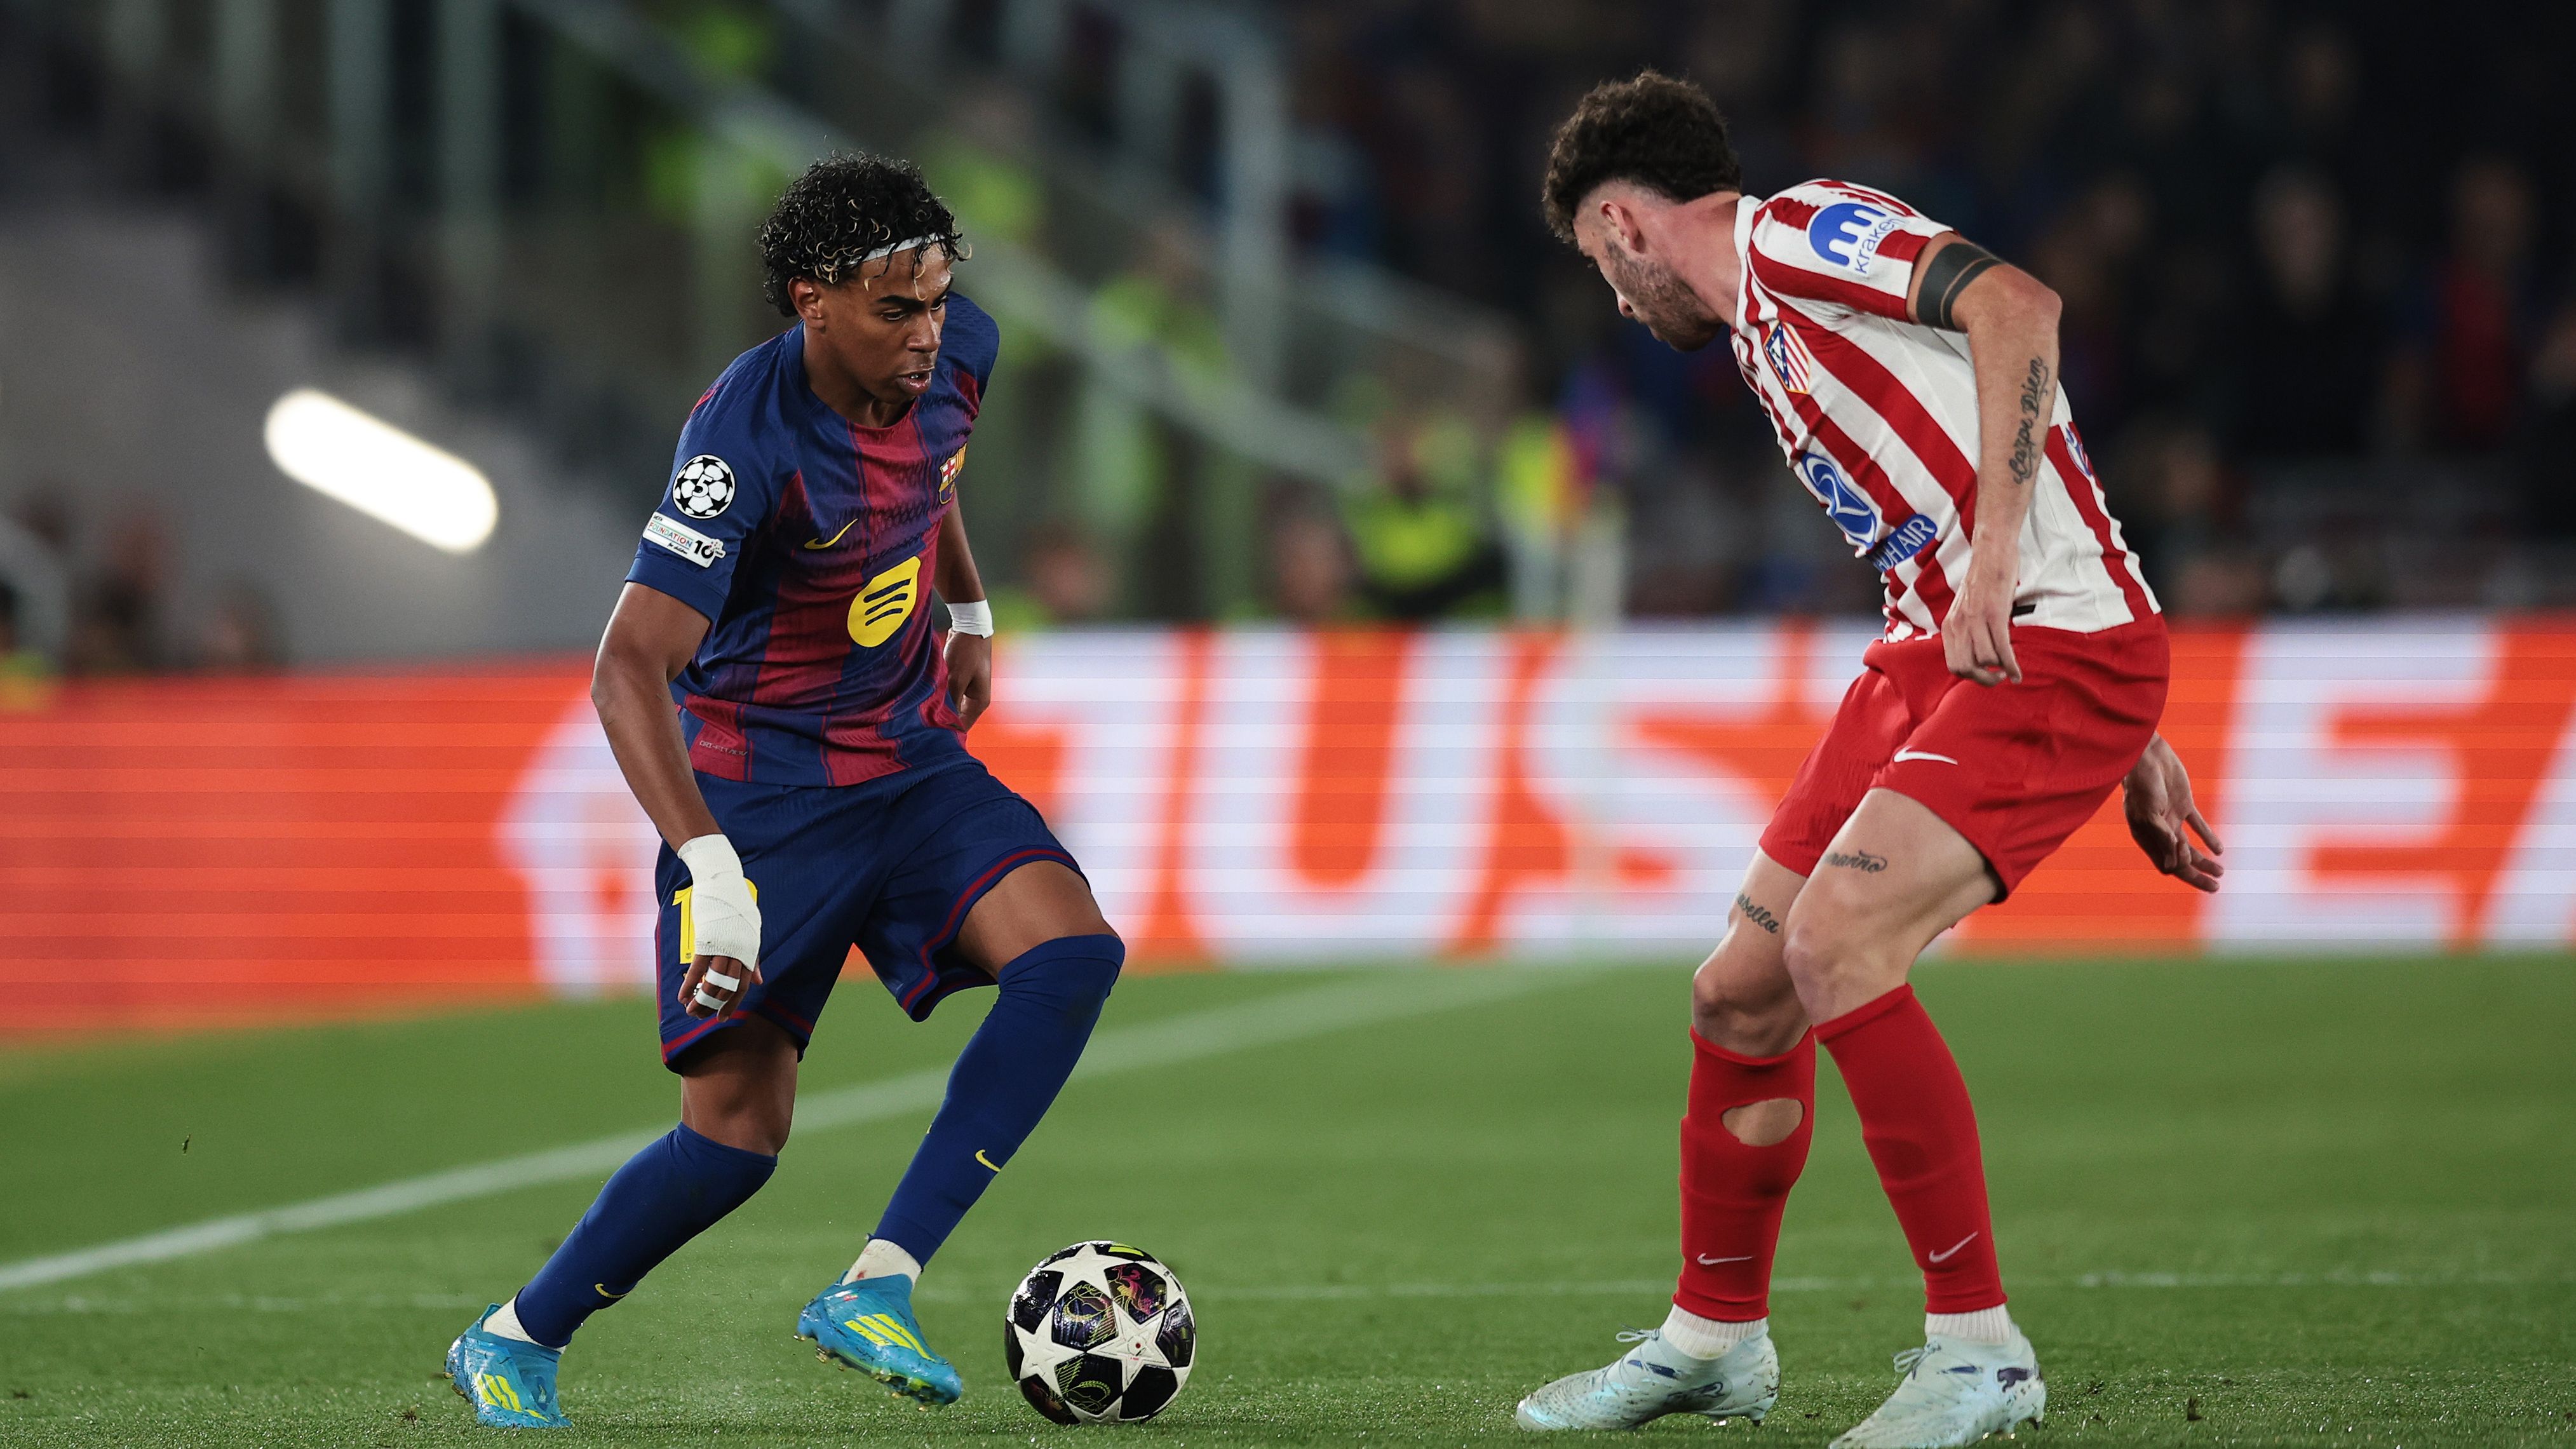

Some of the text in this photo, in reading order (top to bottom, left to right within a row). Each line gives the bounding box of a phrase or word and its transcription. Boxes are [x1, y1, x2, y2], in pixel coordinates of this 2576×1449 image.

[1854, 218, 1908, 274] kraken
[691, 473, 713, 498] 5
[648, 522, 693, 548] FOUNDATION
[1896, 518, 1936, 555] AIR
[991, 623, 1880, 969] JUS
